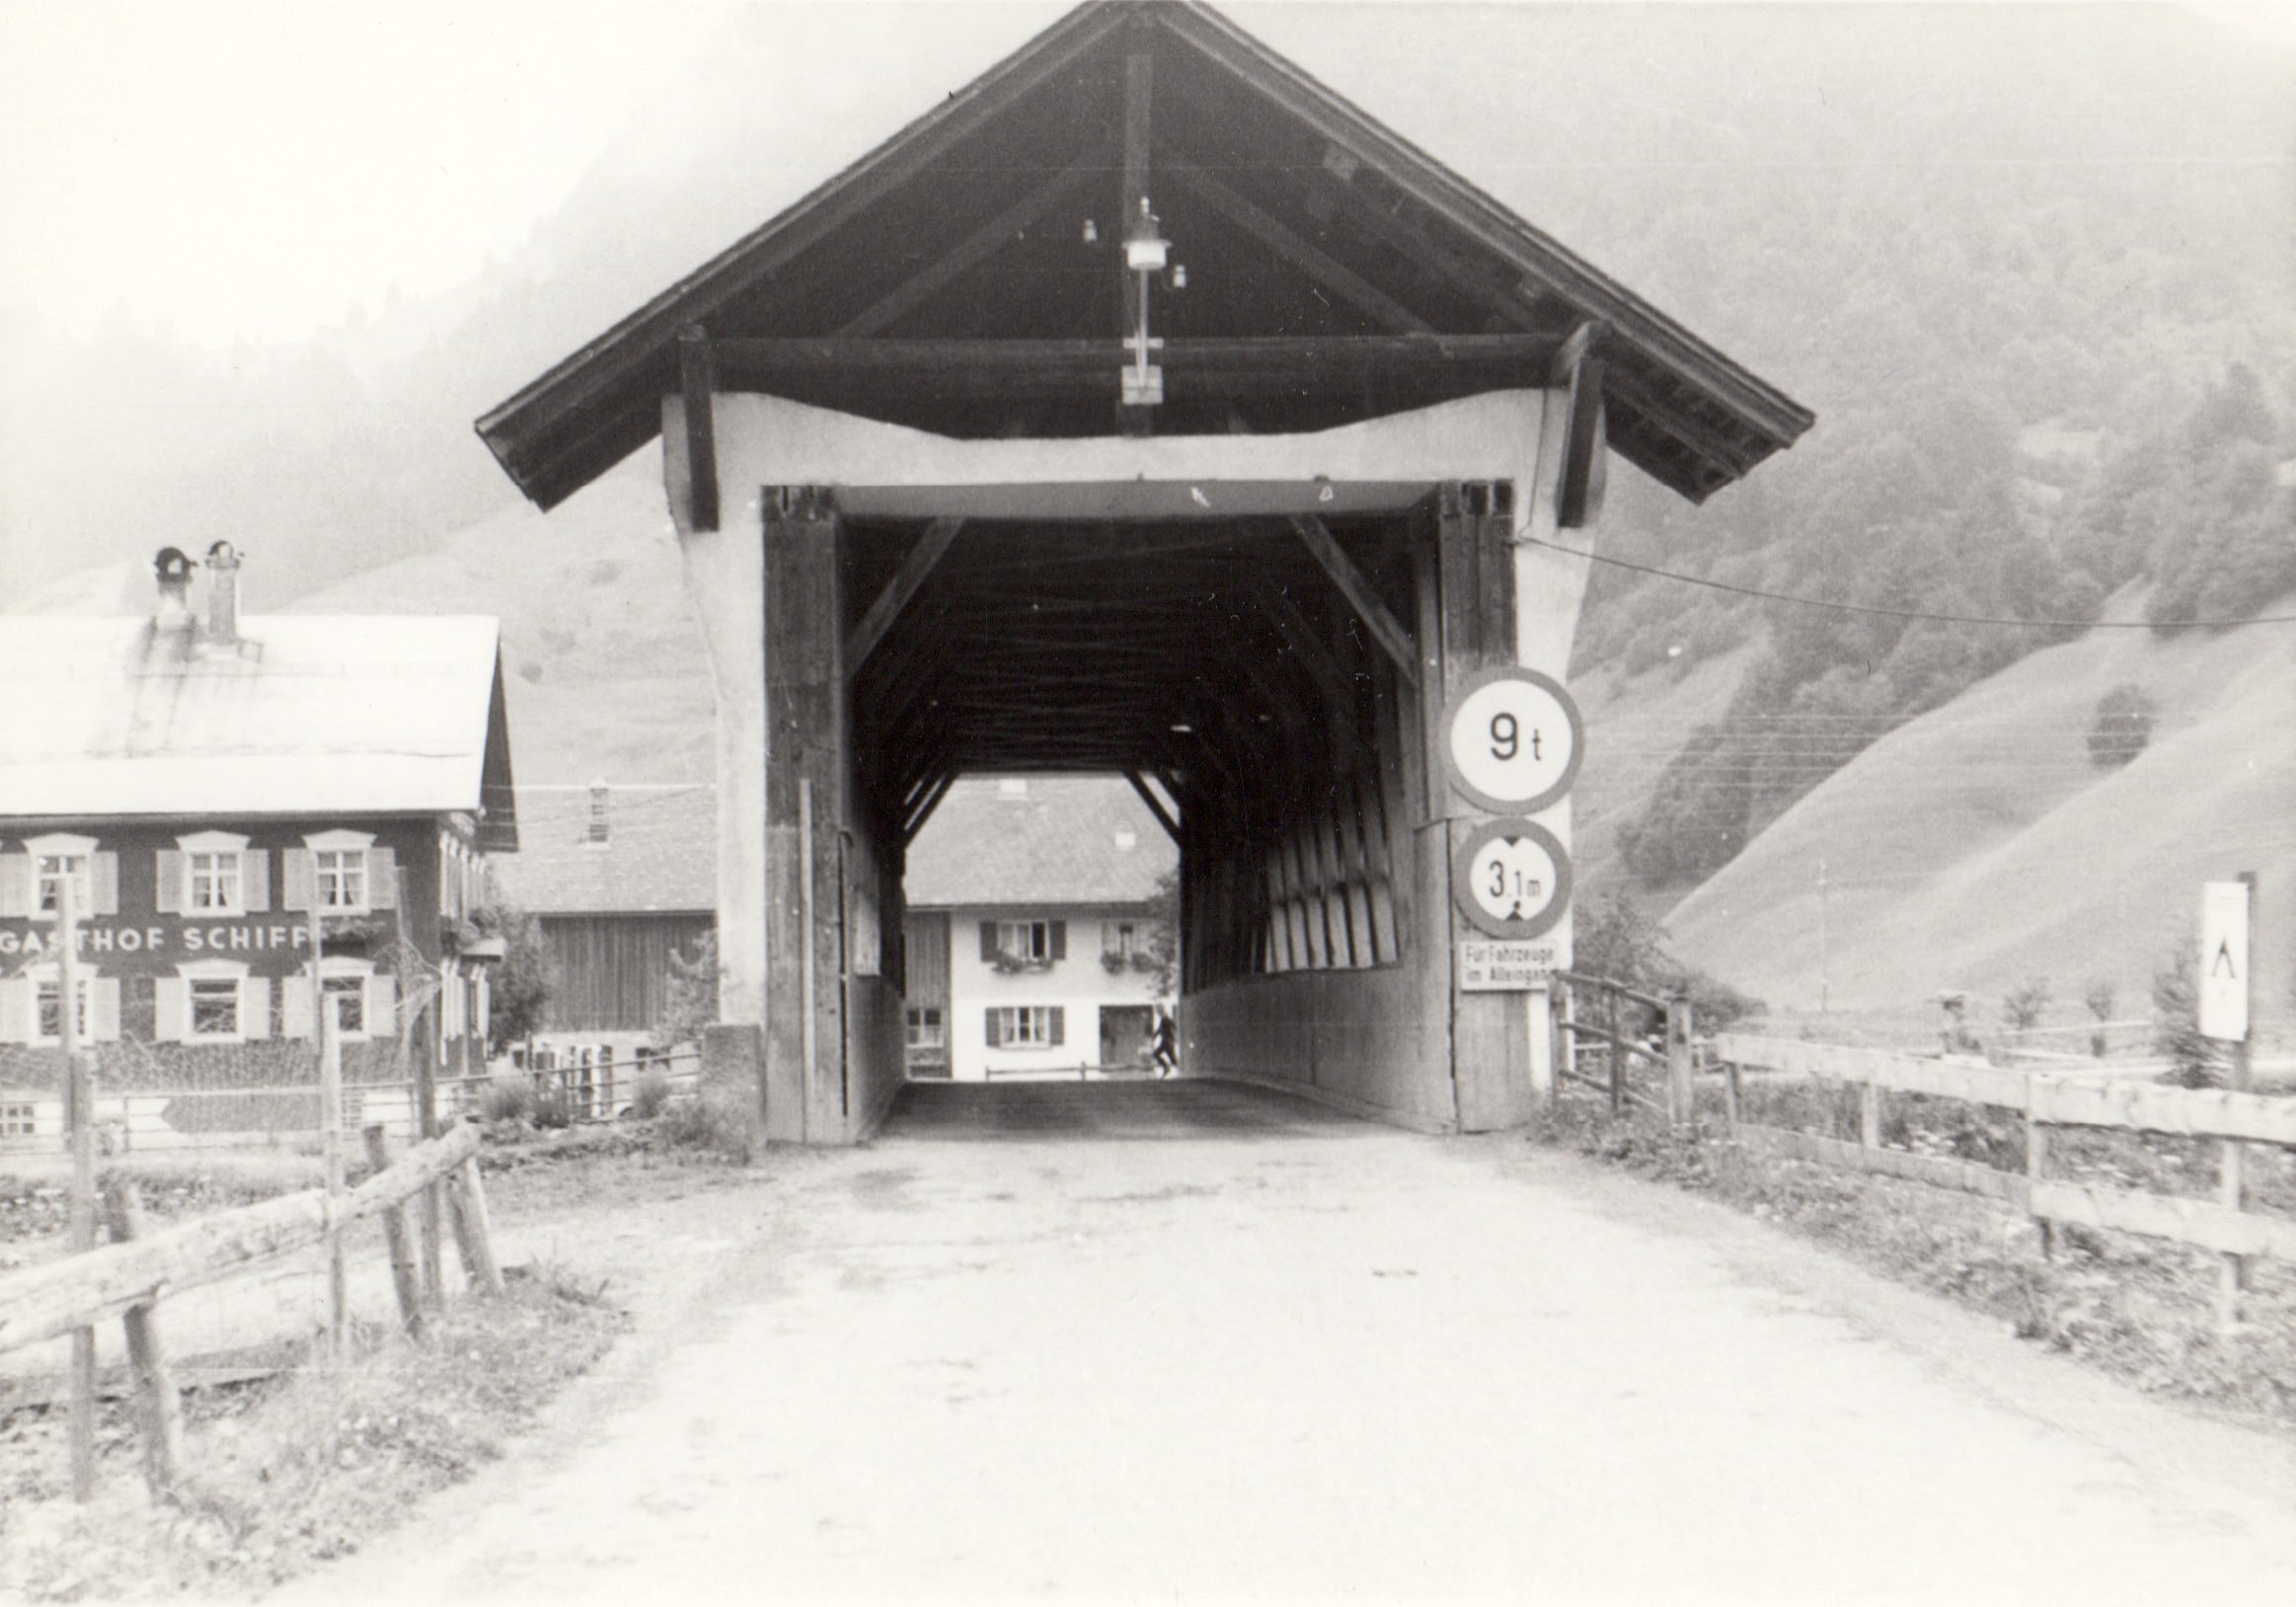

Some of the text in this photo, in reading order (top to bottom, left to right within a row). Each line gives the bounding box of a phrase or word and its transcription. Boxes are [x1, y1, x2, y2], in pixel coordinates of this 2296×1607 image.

[1491, 712, 1542, 761] 9 t
[183, 926, 309, 951] SCHIFF
[1489, 944, 1554, 965] Fahrzeuge
